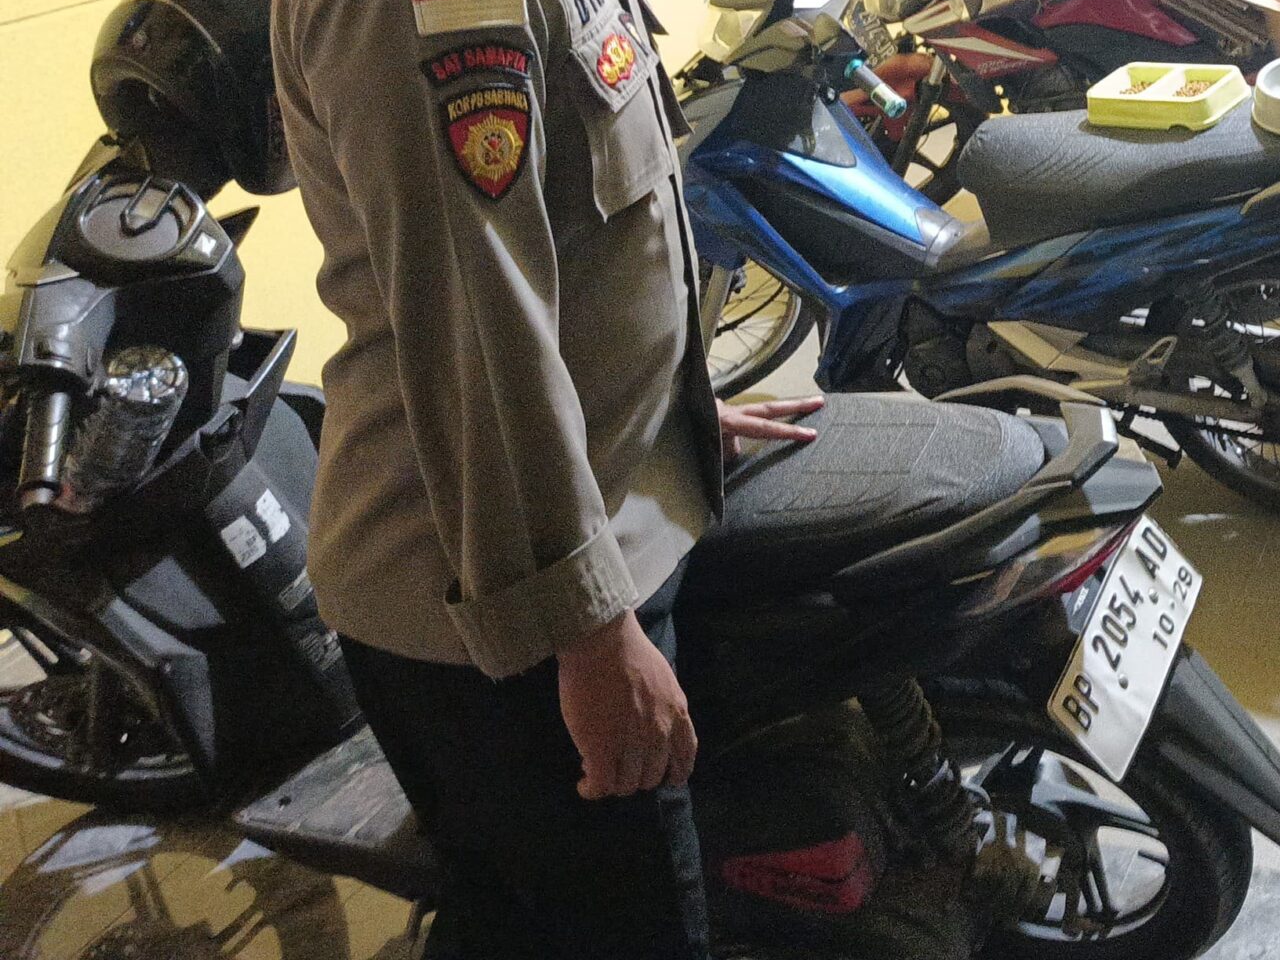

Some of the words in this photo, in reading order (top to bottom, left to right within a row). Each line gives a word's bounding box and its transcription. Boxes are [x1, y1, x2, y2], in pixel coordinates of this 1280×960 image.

[1061, 675, 1101, 733] BP
[1091, 574, 1144, 672] 2054
[1134, 525, 1168, 581] AD
